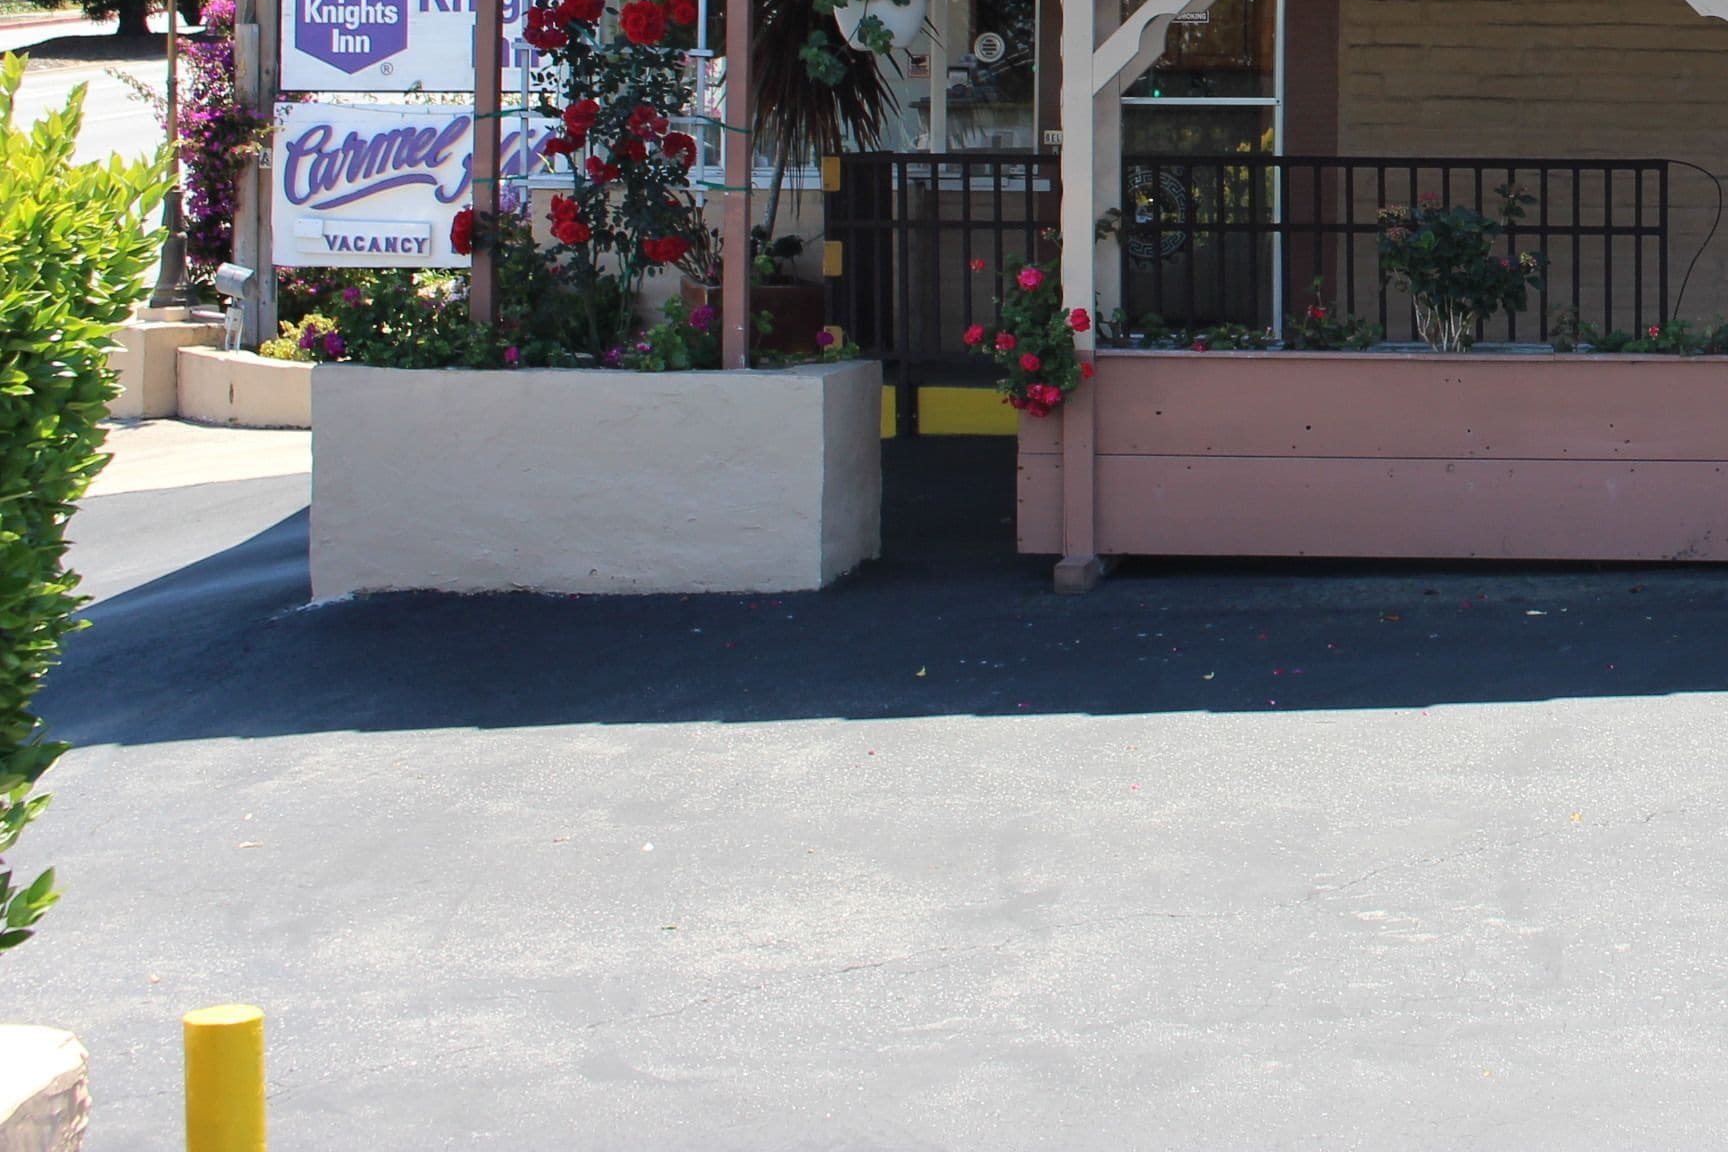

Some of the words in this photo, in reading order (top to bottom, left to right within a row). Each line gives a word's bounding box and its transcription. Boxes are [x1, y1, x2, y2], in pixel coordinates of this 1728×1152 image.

[332, 28, 370, 53] Inn
[284, 115, 471, 205] Carmel
[324, 234, 428, 254] VACANCY
